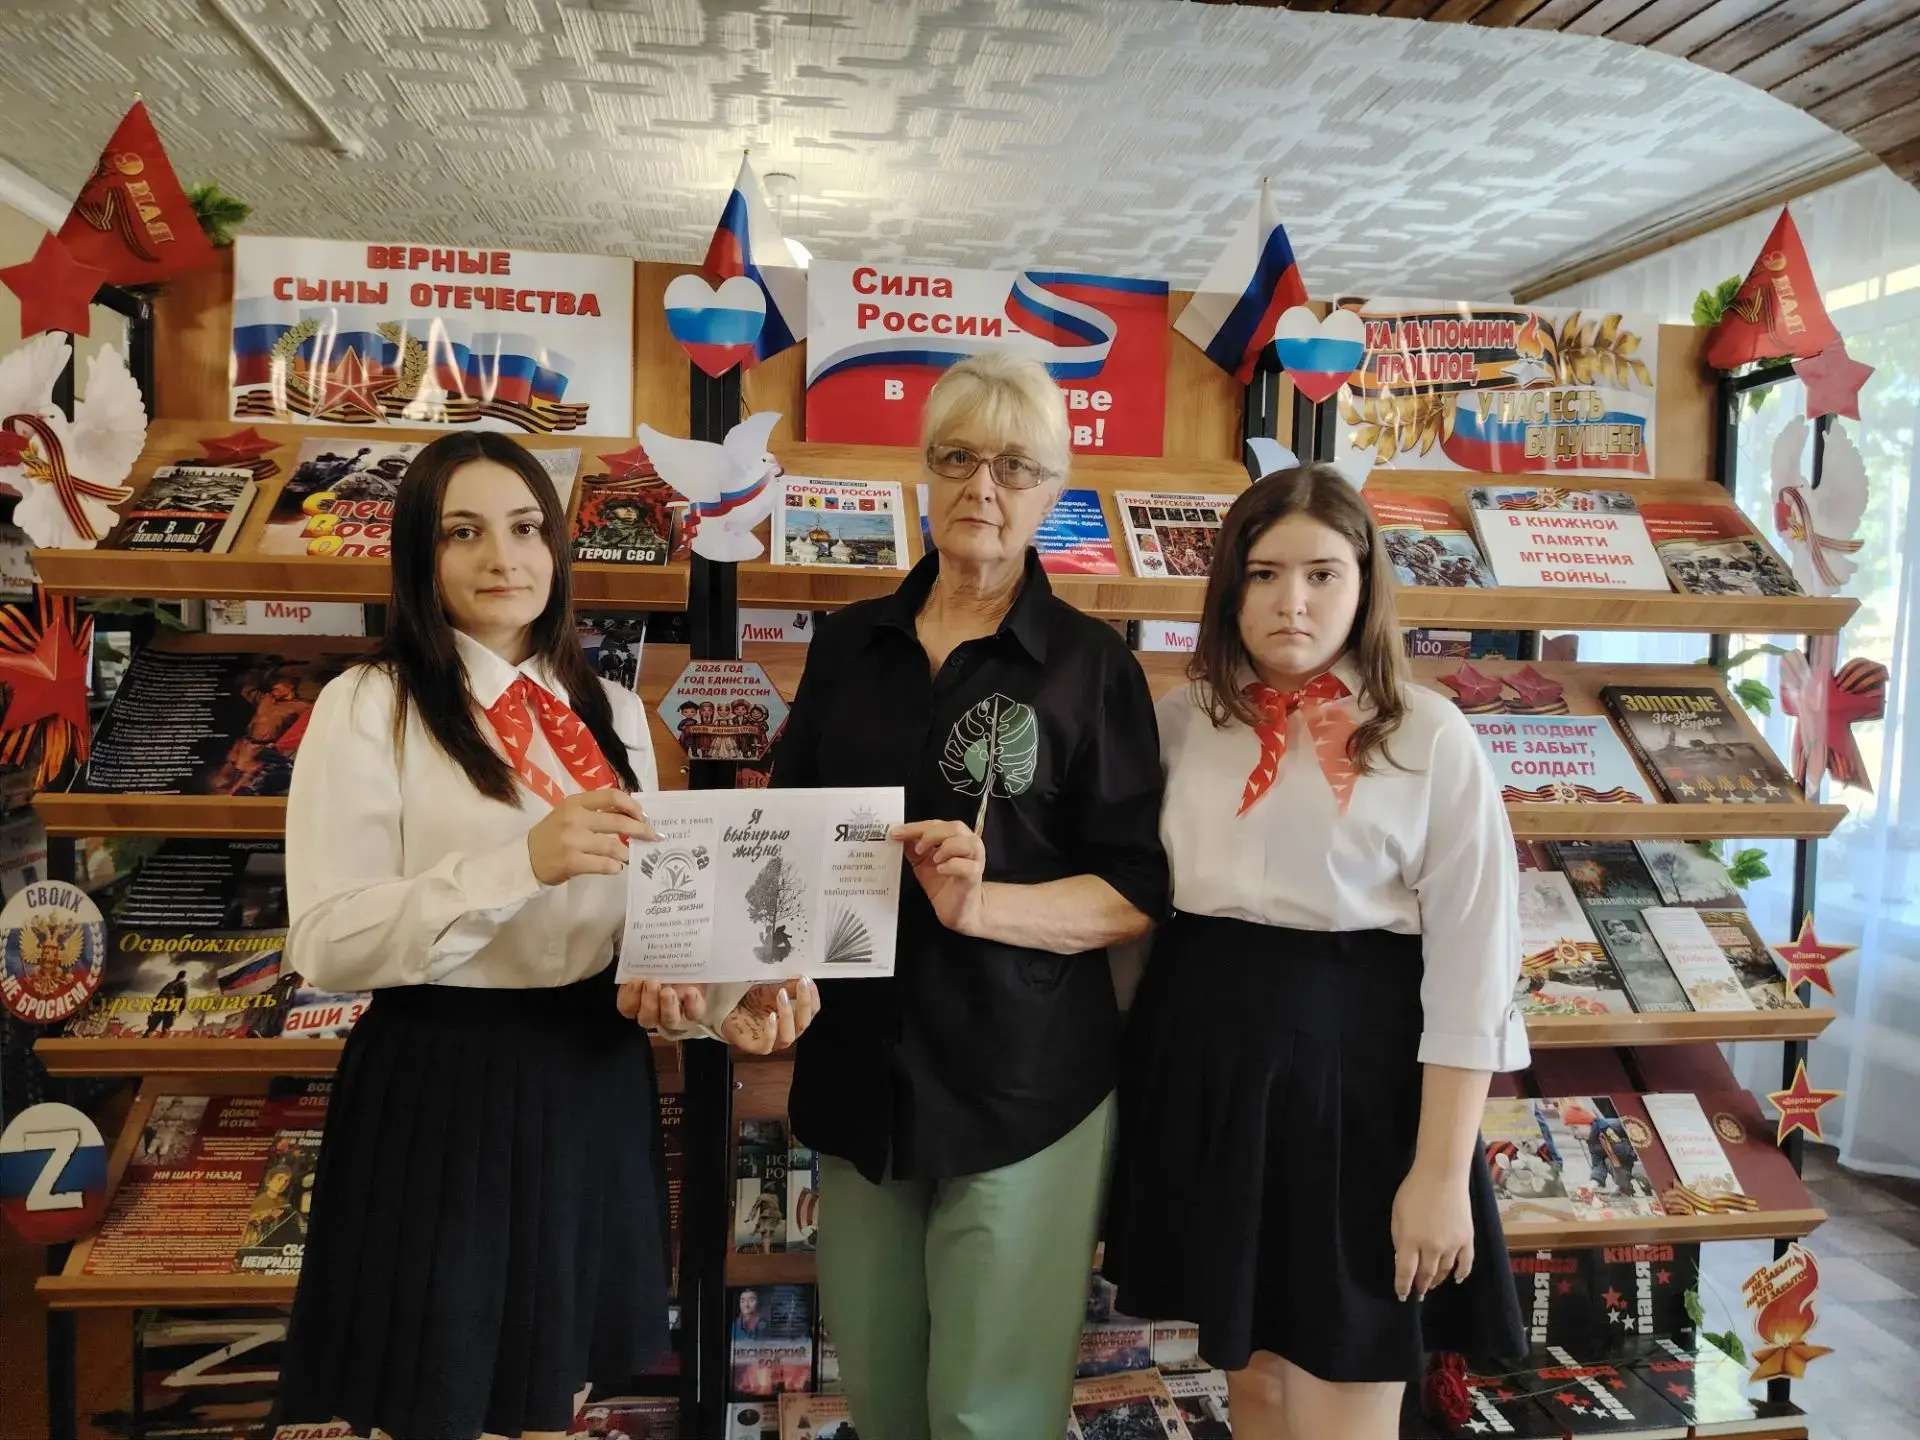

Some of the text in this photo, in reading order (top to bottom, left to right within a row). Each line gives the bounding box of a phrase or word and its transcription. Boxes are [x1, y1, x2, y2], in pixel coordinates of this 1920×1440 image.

[125, 179, 175, 245] МАЯ
[367, 246, 511, 275] ВЕРНЫЕ
[852, 267, 954, 299] Сила
[273, 276, 601, 317] СЫНЫ ОТЕЧЕСТВА
[1770, 275, 1808, 336] МАЯ
[1433, 319, 1516, 350] ПОМНИМ
[1477, 389, 1605, 425] У НАС ЕСТЬ
[1524, 423, 1642, 462] БУДУЩЕЕ!
[785, 484, 892, 497] ГОРОДА РОССИИ
[1508, 515, 1619, 533] В КНИЖНОЙ
[1531, 533, 1609, 548] ПАМЯТИ
[577, 547, 656, 562] ГЕРОИ СВО
[1520, 550, 1634, 566] МГНОВЕНИЯ
[264, 602, 312, 623] Мир
[742, 623, 784, 641] Лики
[1164, 632, 1194, 650] Мир
[1416, 640, 1442, 656] 100
[694, 664, 744, 673] 2026 ГОД
[683, 675, 761, 686] ГОД ЕДИНСТВА
[677, 687, 771, 698] НАРОДОВ РОССИИ
[1619, 694, 1722, 714] ЗОЛОТЫЕ
[1521, 723, 1598, 739] ПОДВИГ
[1491, 739, 1596, 760] НЕ ЗАБЫТ,
[1511, 760, 1596, 778] СОЛДАТ!
[747, 808, 763, 825] Я
[723, 826, 791, 848] выбираю
[834, 824, 849, 842] Я
[26, 887, 84, 914] СВОИХ
[119, 931, 286, 954] Освобождение
[1, 975, 22, 1002] НЕ
[15, 981, 89, 1020] БРОСАЕМ
[186, 990, 278, 1014] область
[24, 1128, 84, 1212] Z
[152, 1171, 243, 1182] НИ ШАГУ НАЗАД
[1741, 1266, 1768, 1294] НИКТО
[1752, 1279, 1763, 1294] НЕ
[1746, 1283, 1774, 1309] НИЧТО
[1757, 1296, 1770, 1309] НЕ
